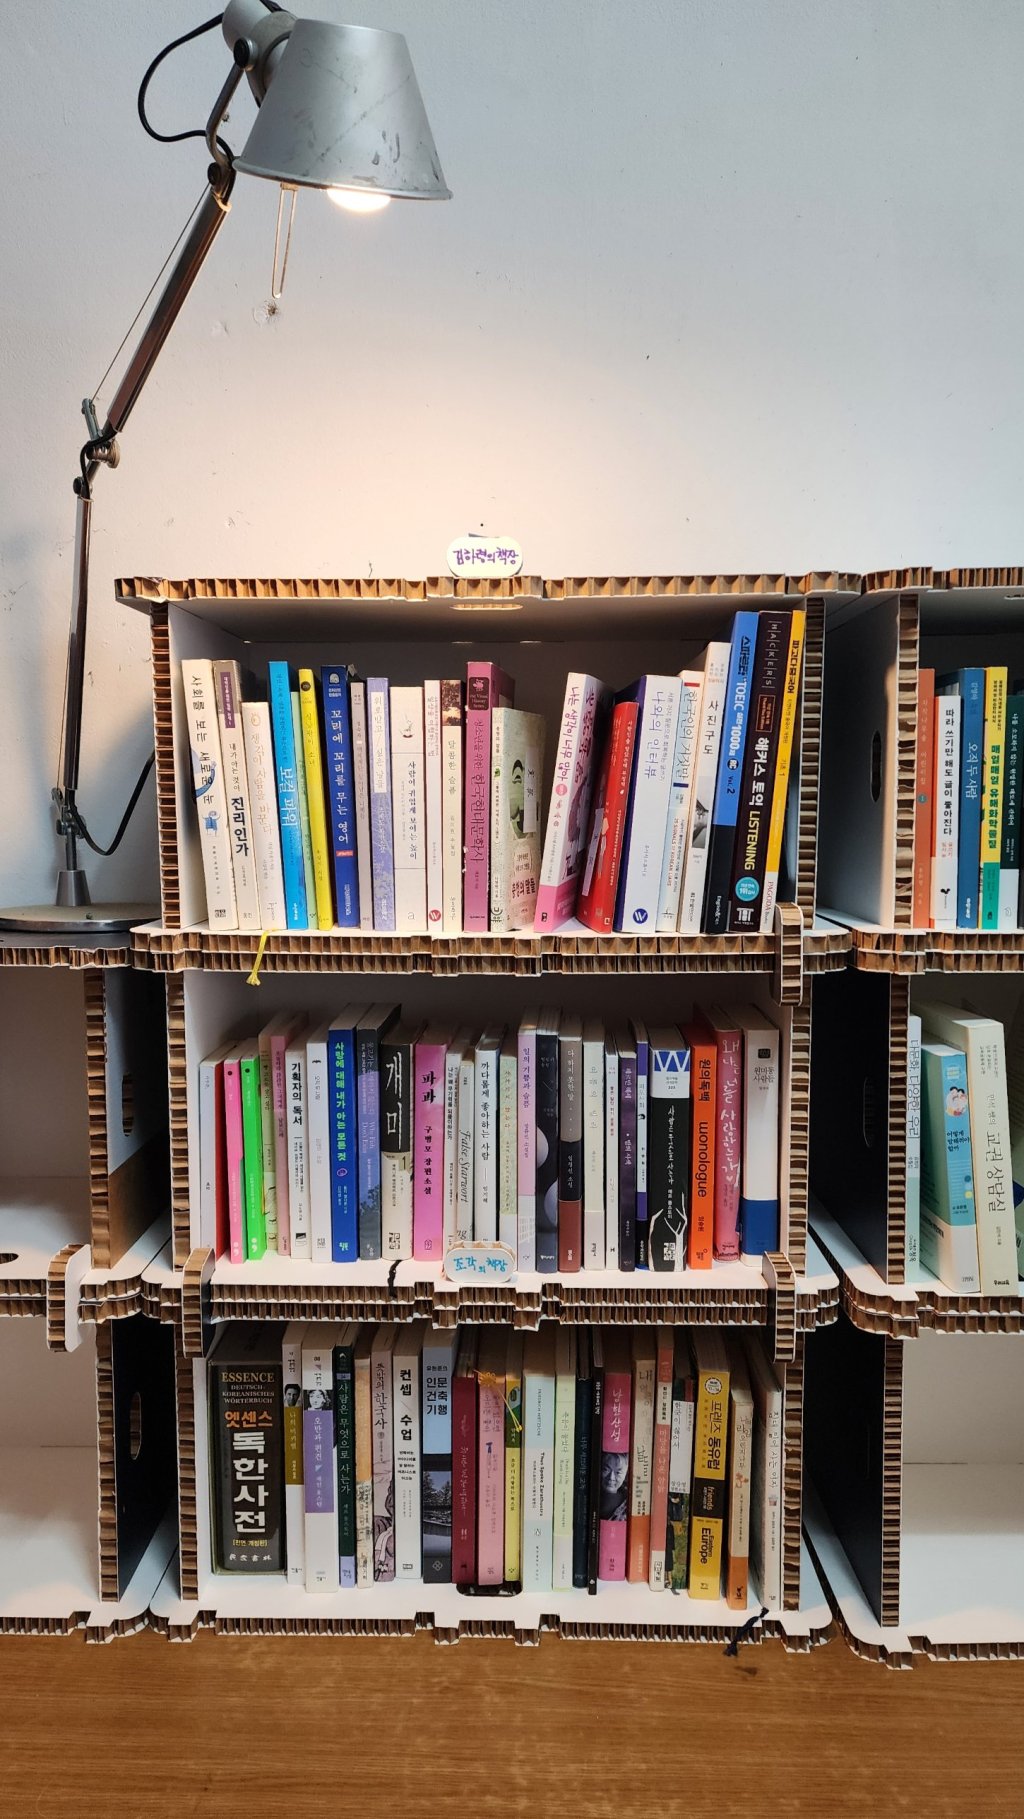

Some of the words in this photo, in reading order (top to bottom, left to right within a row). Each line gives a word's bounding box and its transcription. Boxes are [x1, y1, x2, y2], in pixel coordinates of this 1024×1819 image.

[766, 624, 777, 685] HACKERS
[192, 676, 204, 711] 사회를
[568, 687, 579, 706] 나는
[734, 682, 747, 711] TOEIC
[564, 709, 578, 738] 생각이
[649, 691, 663, 731] 나와의
[680, 692, 697, 739] 한국인의
[945, 708, 954, 726] 따라
[1011, 713, 1018, 725] 나를
[196, 720, 207, 742] 보는
[331, 710, 343, 744] 꼬리에
[251, 733, 265, 762] 생각이
[561, 740, 573, 759] 너무
[945, 730, 953, 756] 쓰기만
[966, 743, 978, 763] 오직
[200, 752, 213, 785] 새로운
[334, 753, 346, 786] 꼬리를
[473, 755, 484, 772] 위한
[644, 739, 659, 778] 인터뷰
[673, 743, 692, 781] 거짓말
[729, 760, 737, 769] RC
[754, 738, 770, 776] 해커스
[944, 760, 953, 777] 해도
[991, 745, 1000, 785] 매일매일
[1010, 754, 1017, 765] 않는
[280, 766, 295, 792] 보컬
[408, 762, 416, 785] 사람이
[557, 761, 571, 781] 많아
[966, 766, 978, 776] 두
[203, 796, 214, 804] 눈
[408, 788, 417, 814] 귀엽게
[749, 781, 764, 806] 토익
[943, 780, 953, 797] 글이
[965, 779, 978, 800] 사람
[1007, 788, 1017, 806] 태도에
[281, 799, 297, 825] 파워
[336, 792, 348, 815] 무는
[231, 797, 249, 856] 진리인가
[409, 818, 417, 841] 보이는
[469, 773, 486, 862] 한국현대문학사
[943, 801, 952, 835] 좋아진다
[338, 821, 348, 843] 영어
[744, 811, 760, 870] LISTENING
[410, 845, 417, 859] 높이
[335, 1042, 345, 1068] 사랑에
[366, 1042, 375, 1067] 물고기는
[524, 1048, 530, 1060] 일의
[722, 1040, 740, 1053] 왜
[568, 1059, 574, 1074] 하지
[723, 1056, 739, 1075] 나는
[292, 1063, 301, 1101] 기획자의
[336, 1071, 345, 1088] 대해
[422, 1071, 436, 1104] 파과
[481, 1062, 489, 1098] 까다롭게
[568, 1077, 574, 1091] 못한
[699, 1059, 711, 1101] 원의독백
[753, 1075, 774, 1083] 사람들
[336, 1092, 346, 1108] 내가
[386, 1051, 402, 1151] 개미
[524, 1093, 530, 1108] 슬픔
[908, 1076, 920, 1112] 다양한
[293, 1105, 302, 1125] 독서
[337, 1112, 346, 1130] 아는
[481, 1102, 490, 1138] 좋아하는
[908, 1116, 920, 1139] 우리
[337, 1132, 347, 1150] 모든
[424, 1125, 433, 1152] 구병모
[460, 1130, 472, 1157] False
[481, 1142, 489, 1160] 사람
[720, 1109, 738, 1173] 사랑하는가
[337, 1152, 346, 1161] 것
[403, 1156, 406, 1170] 1
[695, 1121, 710, 1198] wonologue
[424, 1159, 432, 1195] 장편소설
[459, 1158, 471, 1203] Starwort
[222, 1373, 274, 1383] ESSENCE
[400, 1369, 411, 1396] 컨셉
[427, 1377, 447, 1388] 인문
[339, 1384, 348, 1414] 사람은
[427, 1391, 448, 1402] 건축
[427, 1404, 448, 1415] 기행
[225, 1411, 273, 1427] 엣센스
[374, 1393, 388, 1429] 한국사
[611, 1388, 628, 1442] 남한산성
[710, 1401, 721, 1434] 프렌즈
[314, 1417, 322, 1440] 오만과
[340, 1419, 350, 1459] 무엇으로
[400, 1414, 412, 1440] 수업
[707, 1436, 721, 1471] 동유럽
[232, 1431, 269, 1533] 독한사전
[340, 1464, 350, 1494] 사는가
[701, 1527, 711, 1564] Europe
